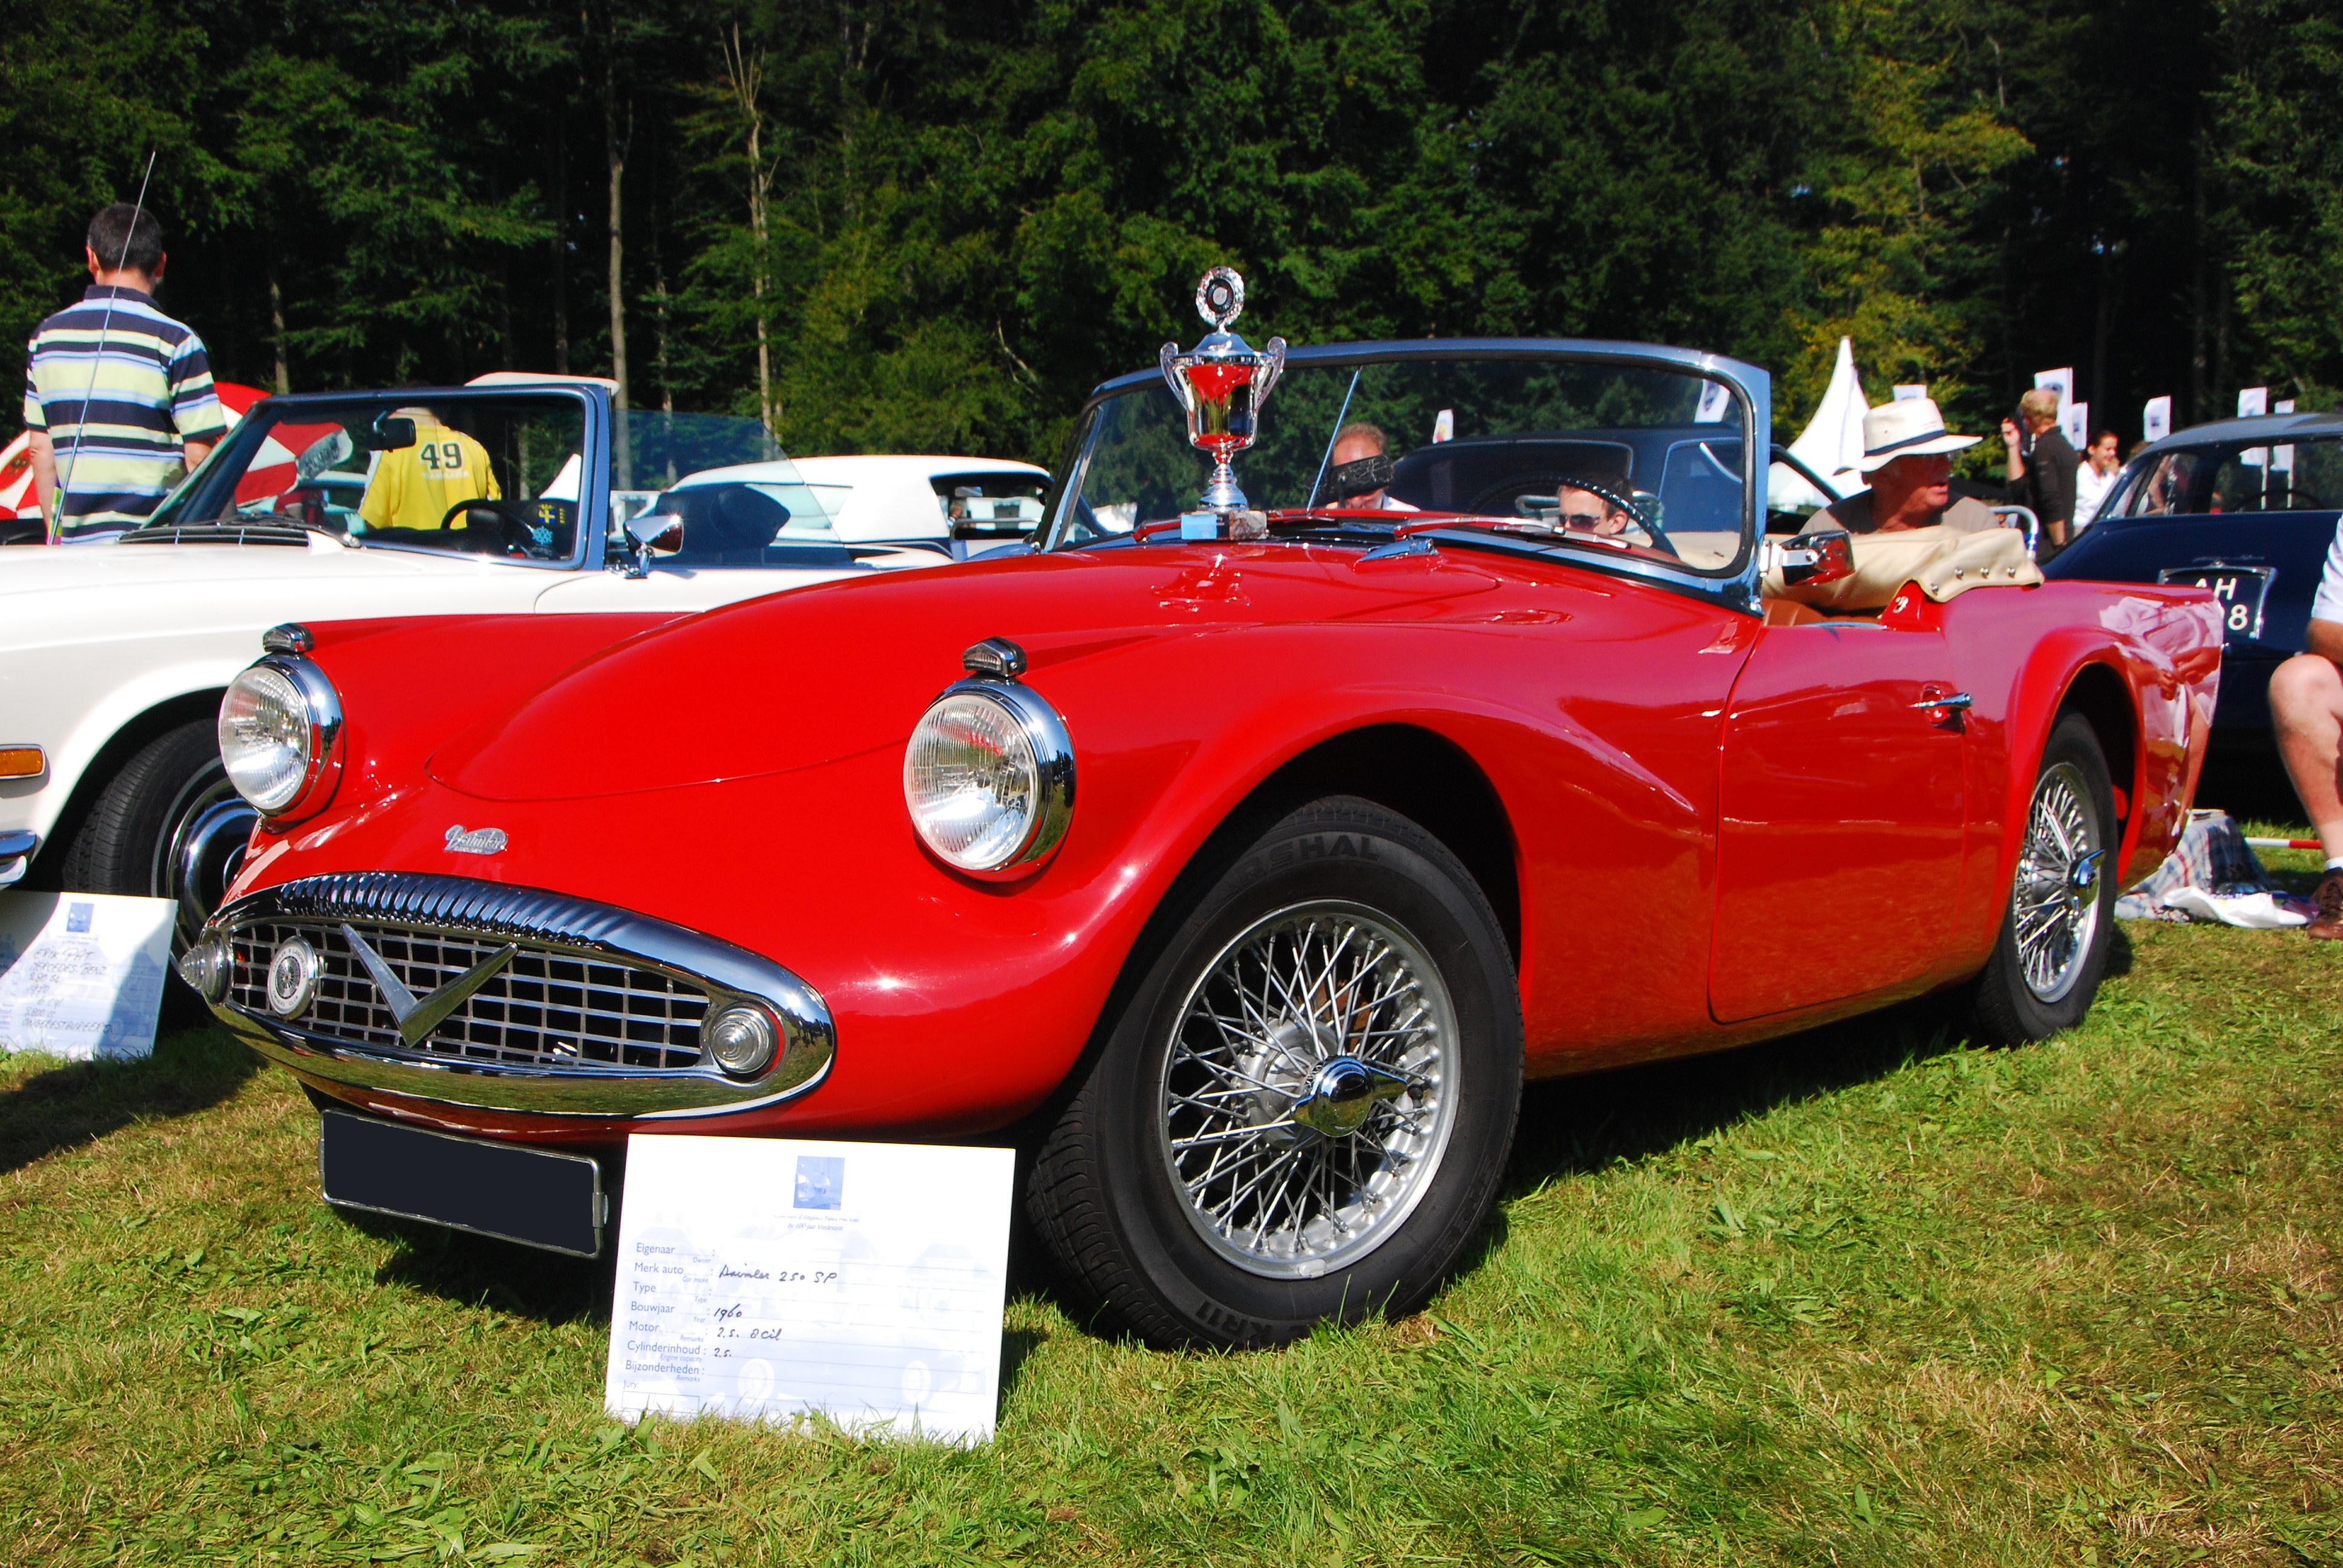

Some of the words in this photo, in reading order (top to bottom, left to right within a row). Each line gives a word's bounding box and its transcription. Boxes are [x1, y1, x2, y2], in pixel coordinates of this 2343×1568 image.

[421, 442, 462, 470] 49
[636, 1243, 675, 1256] Eigenaar
[634, 1263, 659, 1273] Merk
[662, 1266, 684, 1275] auto
[779, 1272, 805, 1282] 250
[814, 1272, 837, 1284] SP
[633, 1281, 656, 1295] Type
[631, 1301, 675, 1315] Bouwjaar
[713, 1302, 742, 1322] 1960
[629, 1321, 660, 1332] Motor
[627, 1340, 701, 1355] Cylinderinhoud
[625, 1359, 700, 1375] Bijzonderheden
[676, 1374, 701, 1383] Remarks
